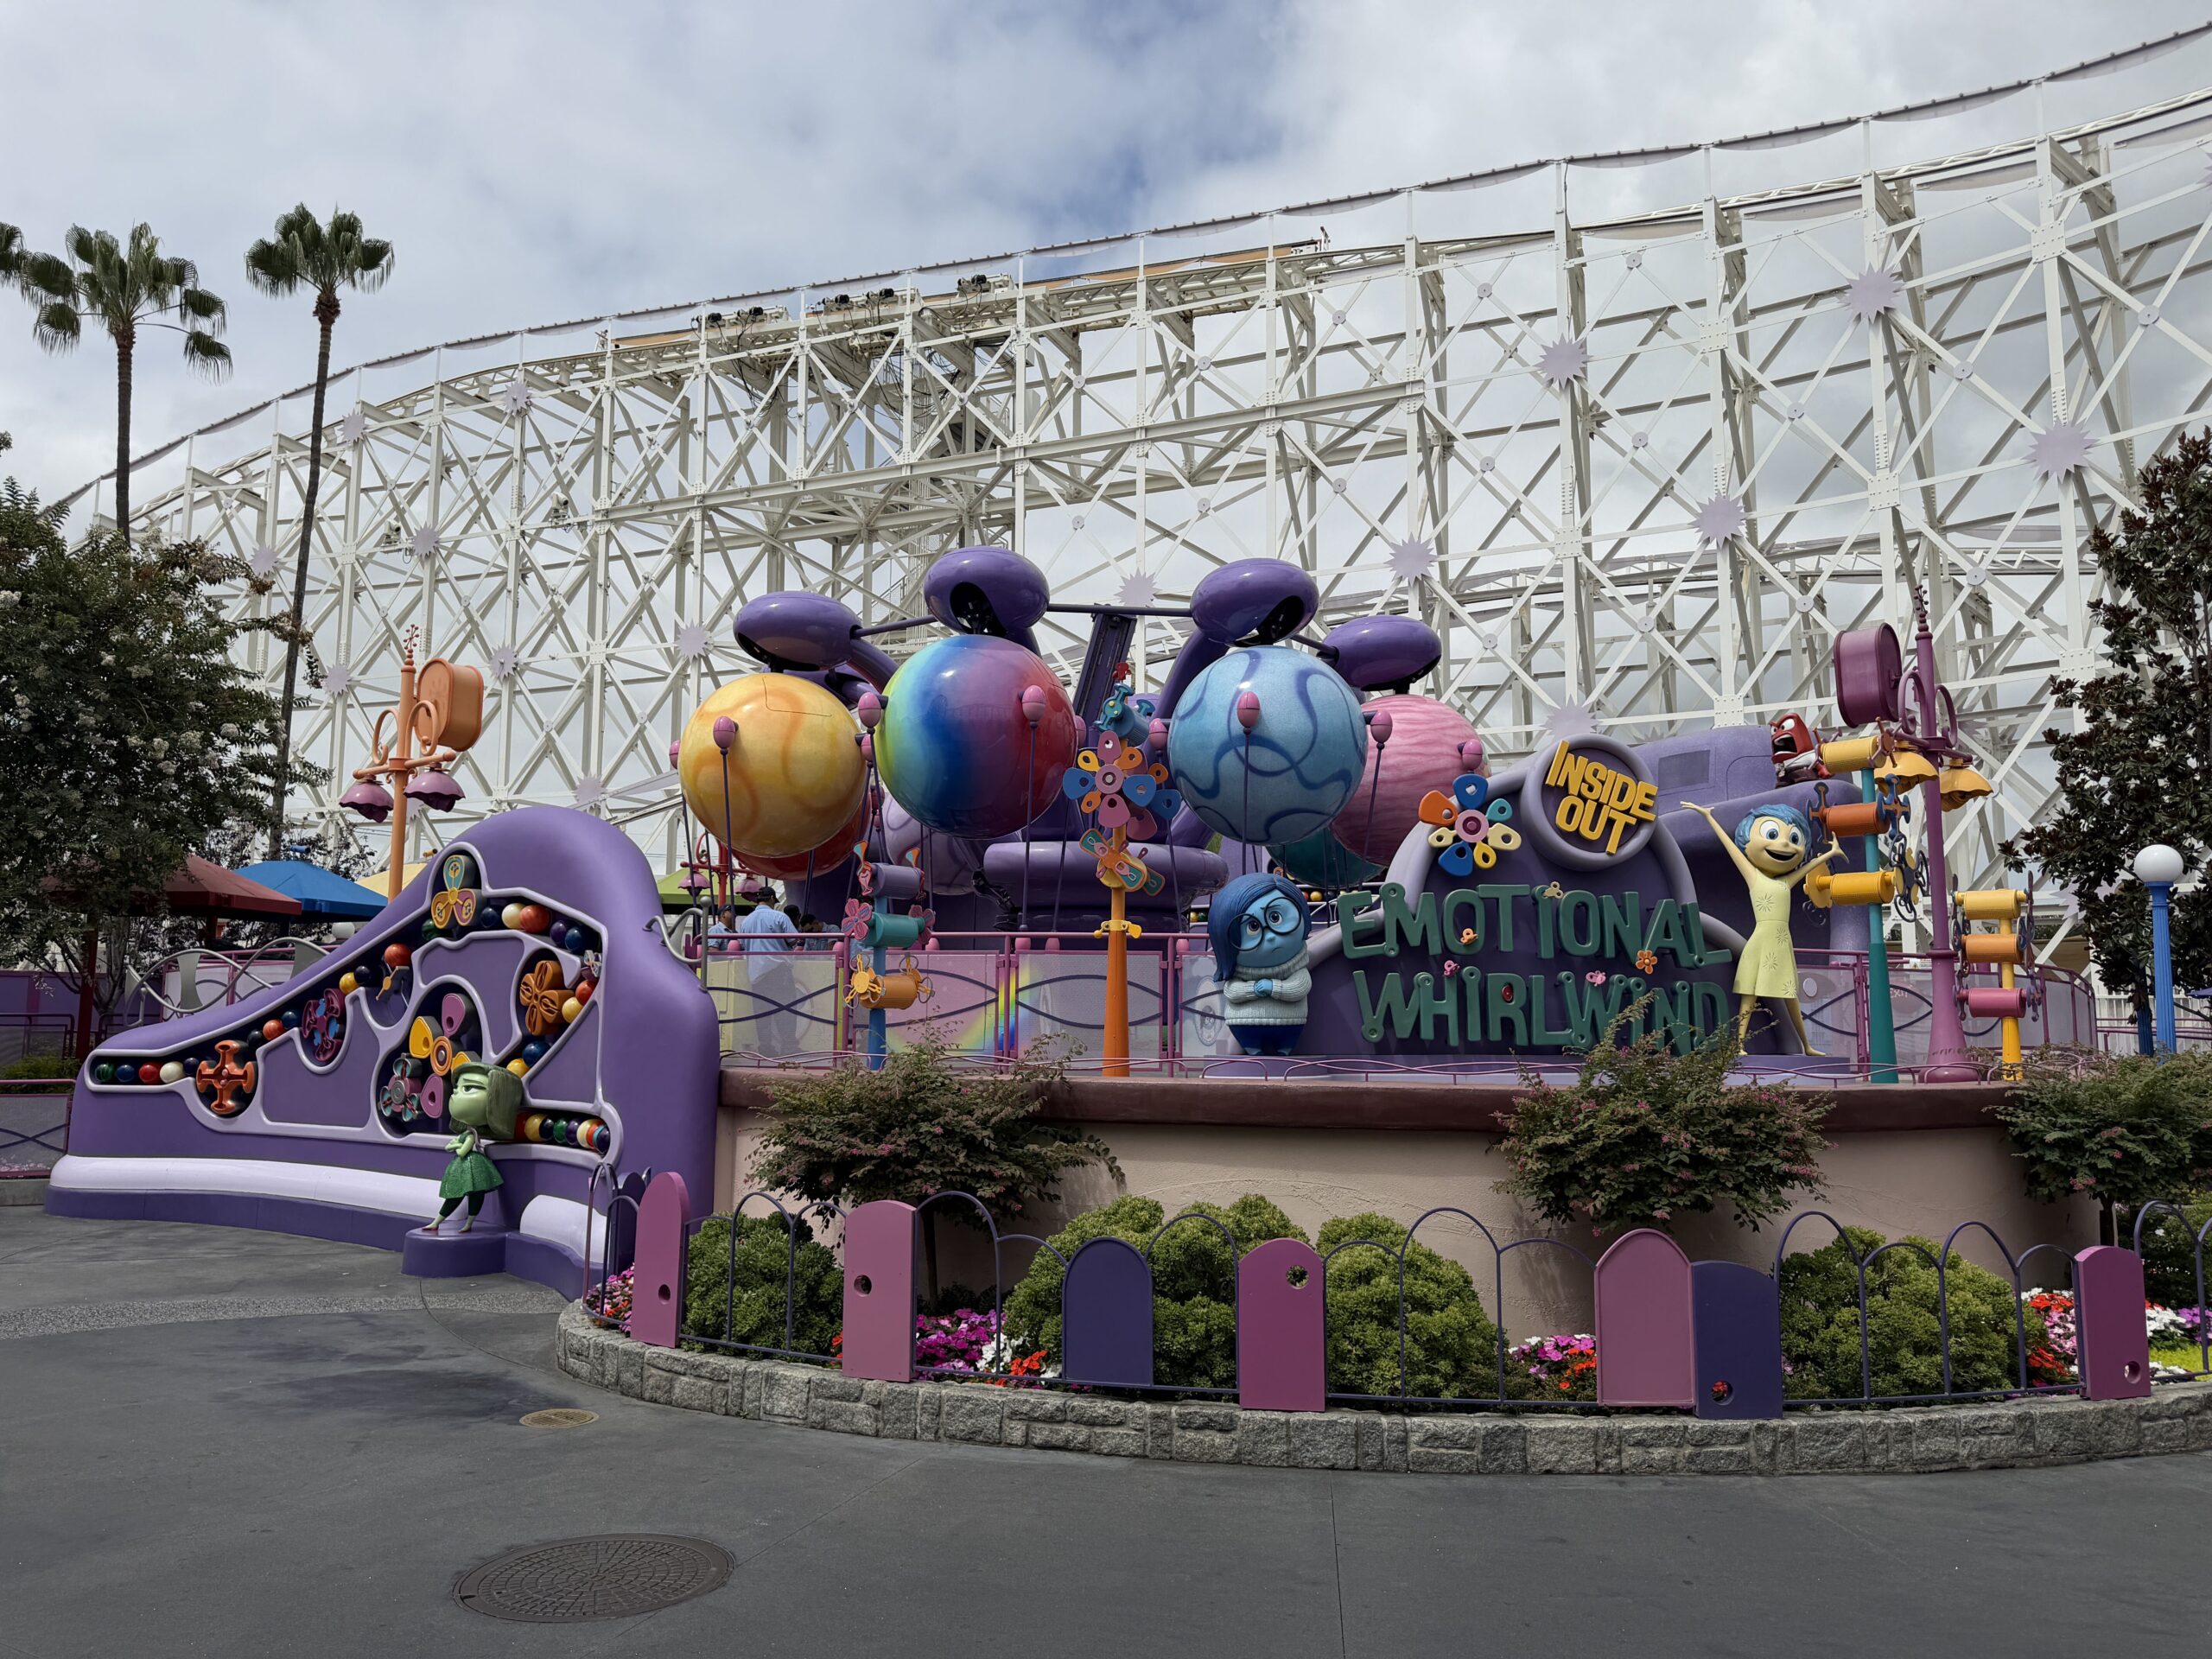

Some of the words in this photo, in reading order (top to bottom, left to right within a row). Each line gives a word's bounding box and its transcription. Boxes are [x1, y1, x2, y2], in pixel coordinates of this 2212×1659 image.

[1545, 740, 1658, 822] INSIDE
[1555, 795, 1637, 855] OUT
[1338, 882, 1732, 968] EMOTIONAL
[1352, 966, 1730, 1056] WHIRLWIND
